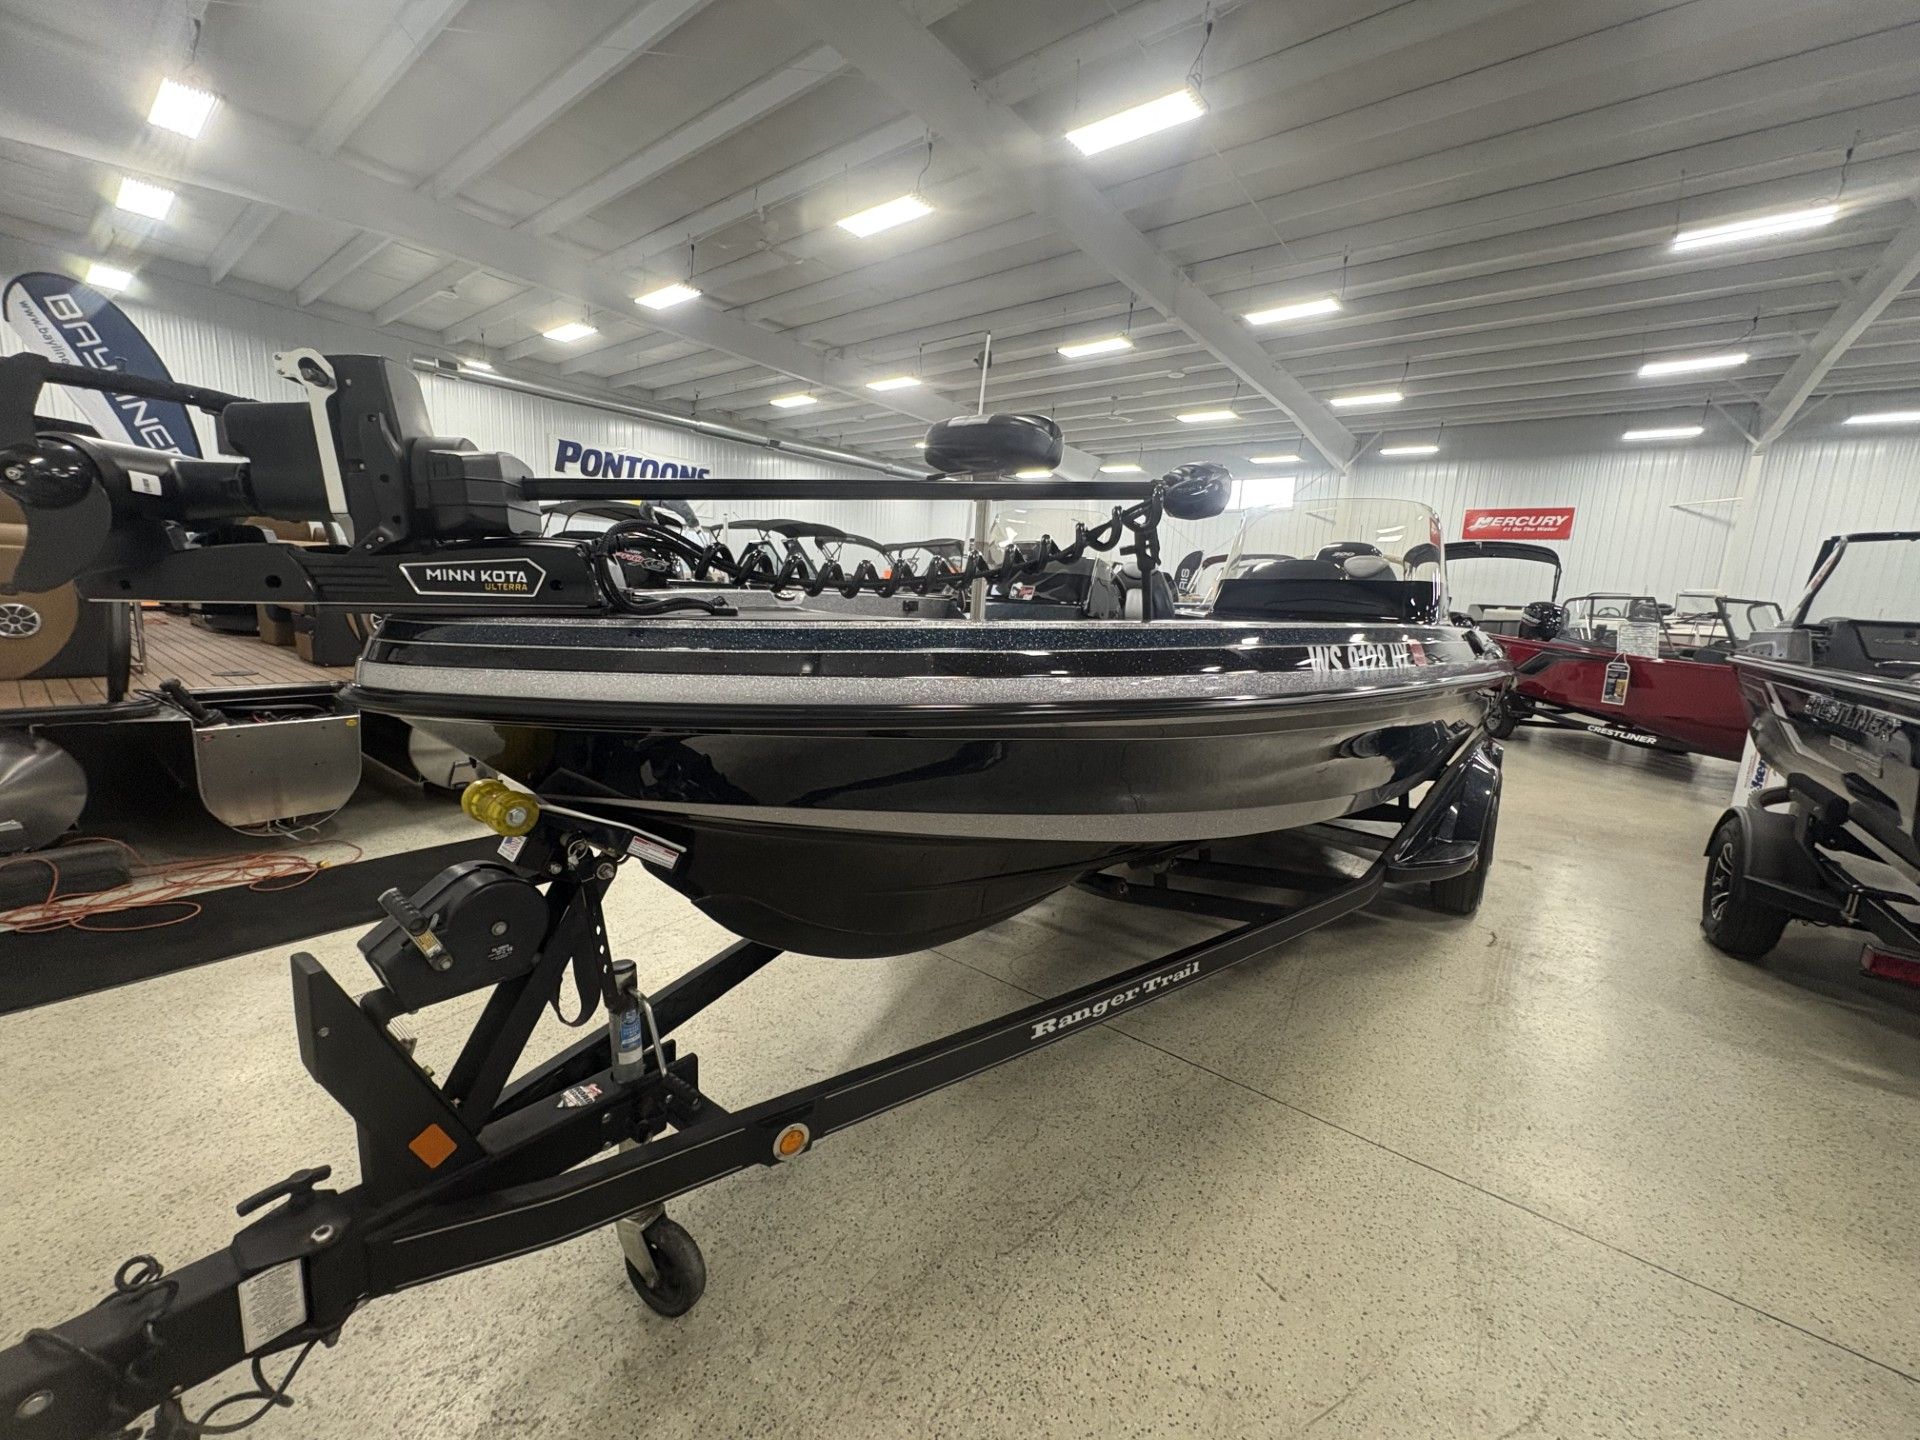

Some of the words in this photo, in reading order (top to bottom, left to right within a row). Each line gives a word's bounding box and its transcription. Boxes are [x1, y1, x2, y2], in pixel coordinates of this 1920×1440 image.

[1468, 515, 1570, 531] MERCURY
[425, 568, 476, 582] MINN
[480, 570, 528, 583] KOTA
[485, 583, 528, 591] ULTERRA
[1587, 724, 1658, 745] CRESTLINER
[1030, 986, 1140, 1040] Ranger
[1142, 961, 1200, 994] Trail
